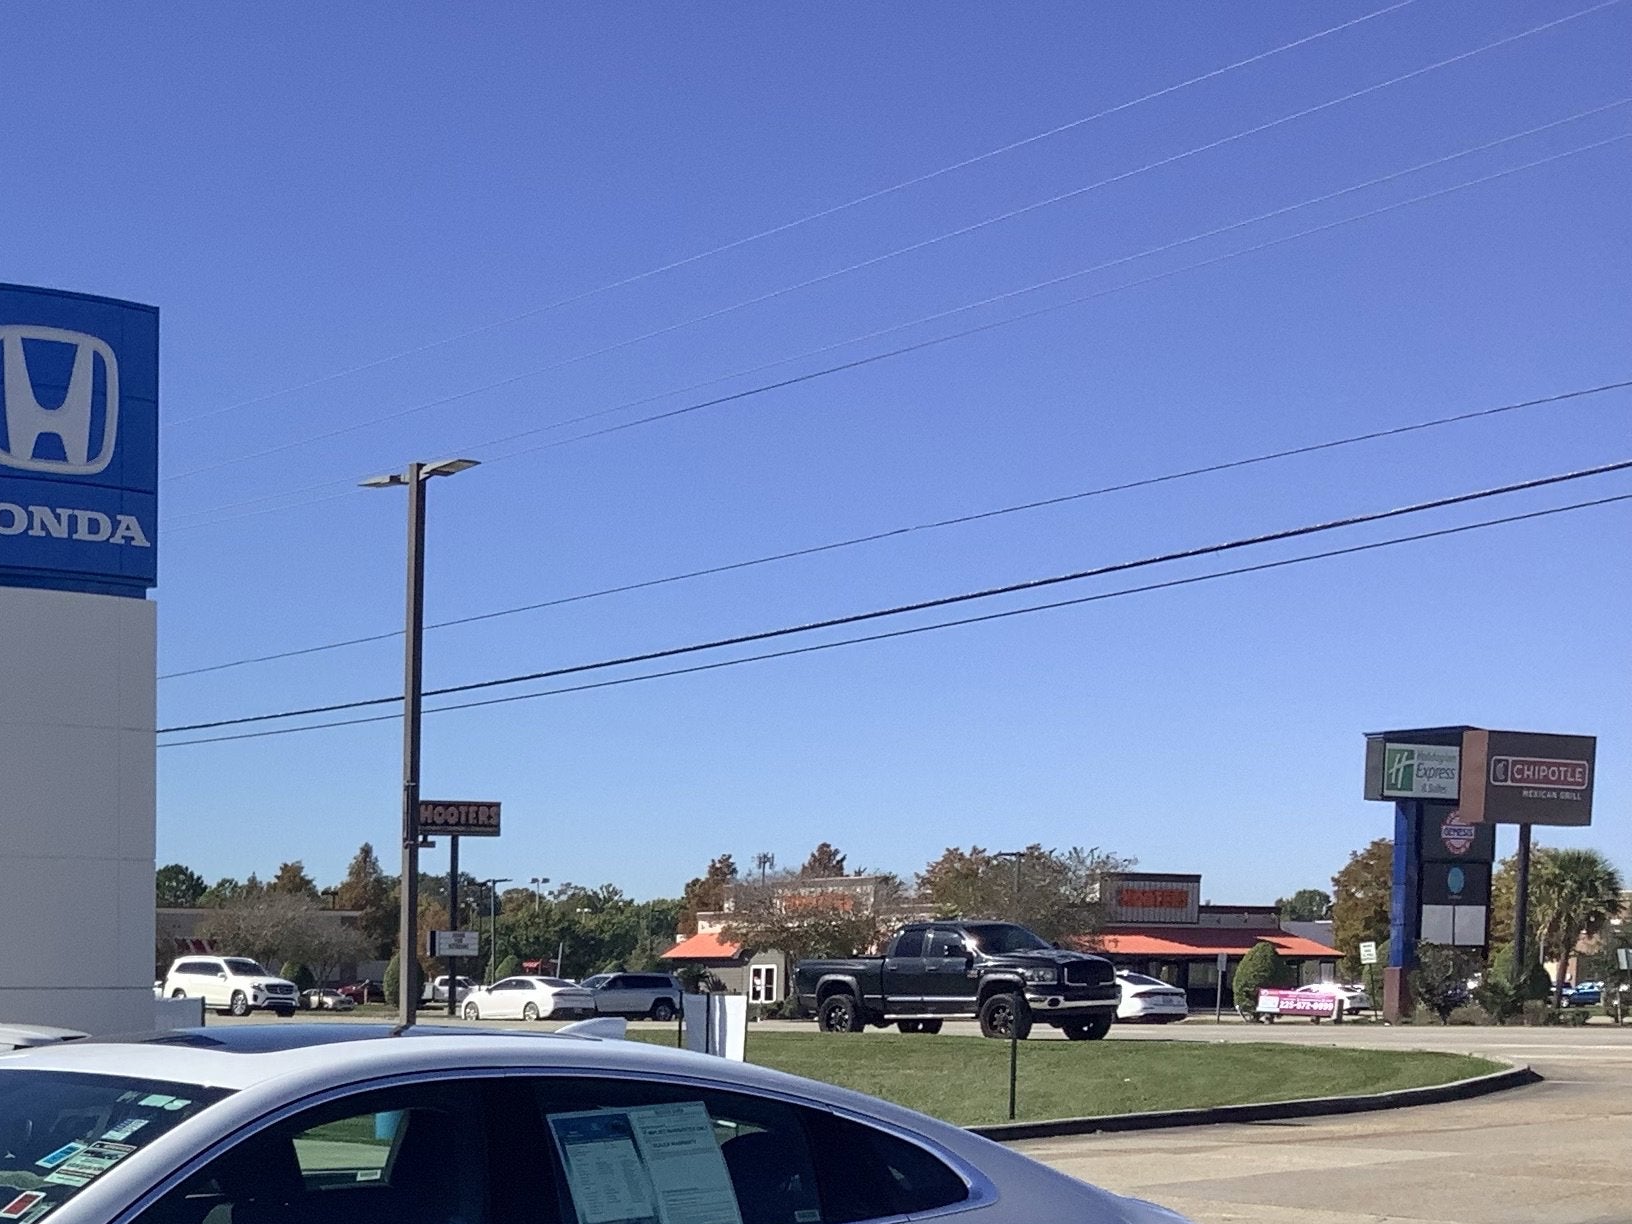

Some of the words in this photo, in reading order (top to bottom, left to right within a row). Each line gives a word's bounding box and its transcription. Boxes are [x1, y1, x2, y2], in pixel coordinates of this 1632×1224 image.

[1416, 762, 1456, 781] Express
[1513, 763, 1584, 783] CHIPOTLE
[1522, 790, 1558, 799] MEXICAN
[1559, 791, 1582, 801] GRILL
[419, 804, 498, 826] HOOTERS
